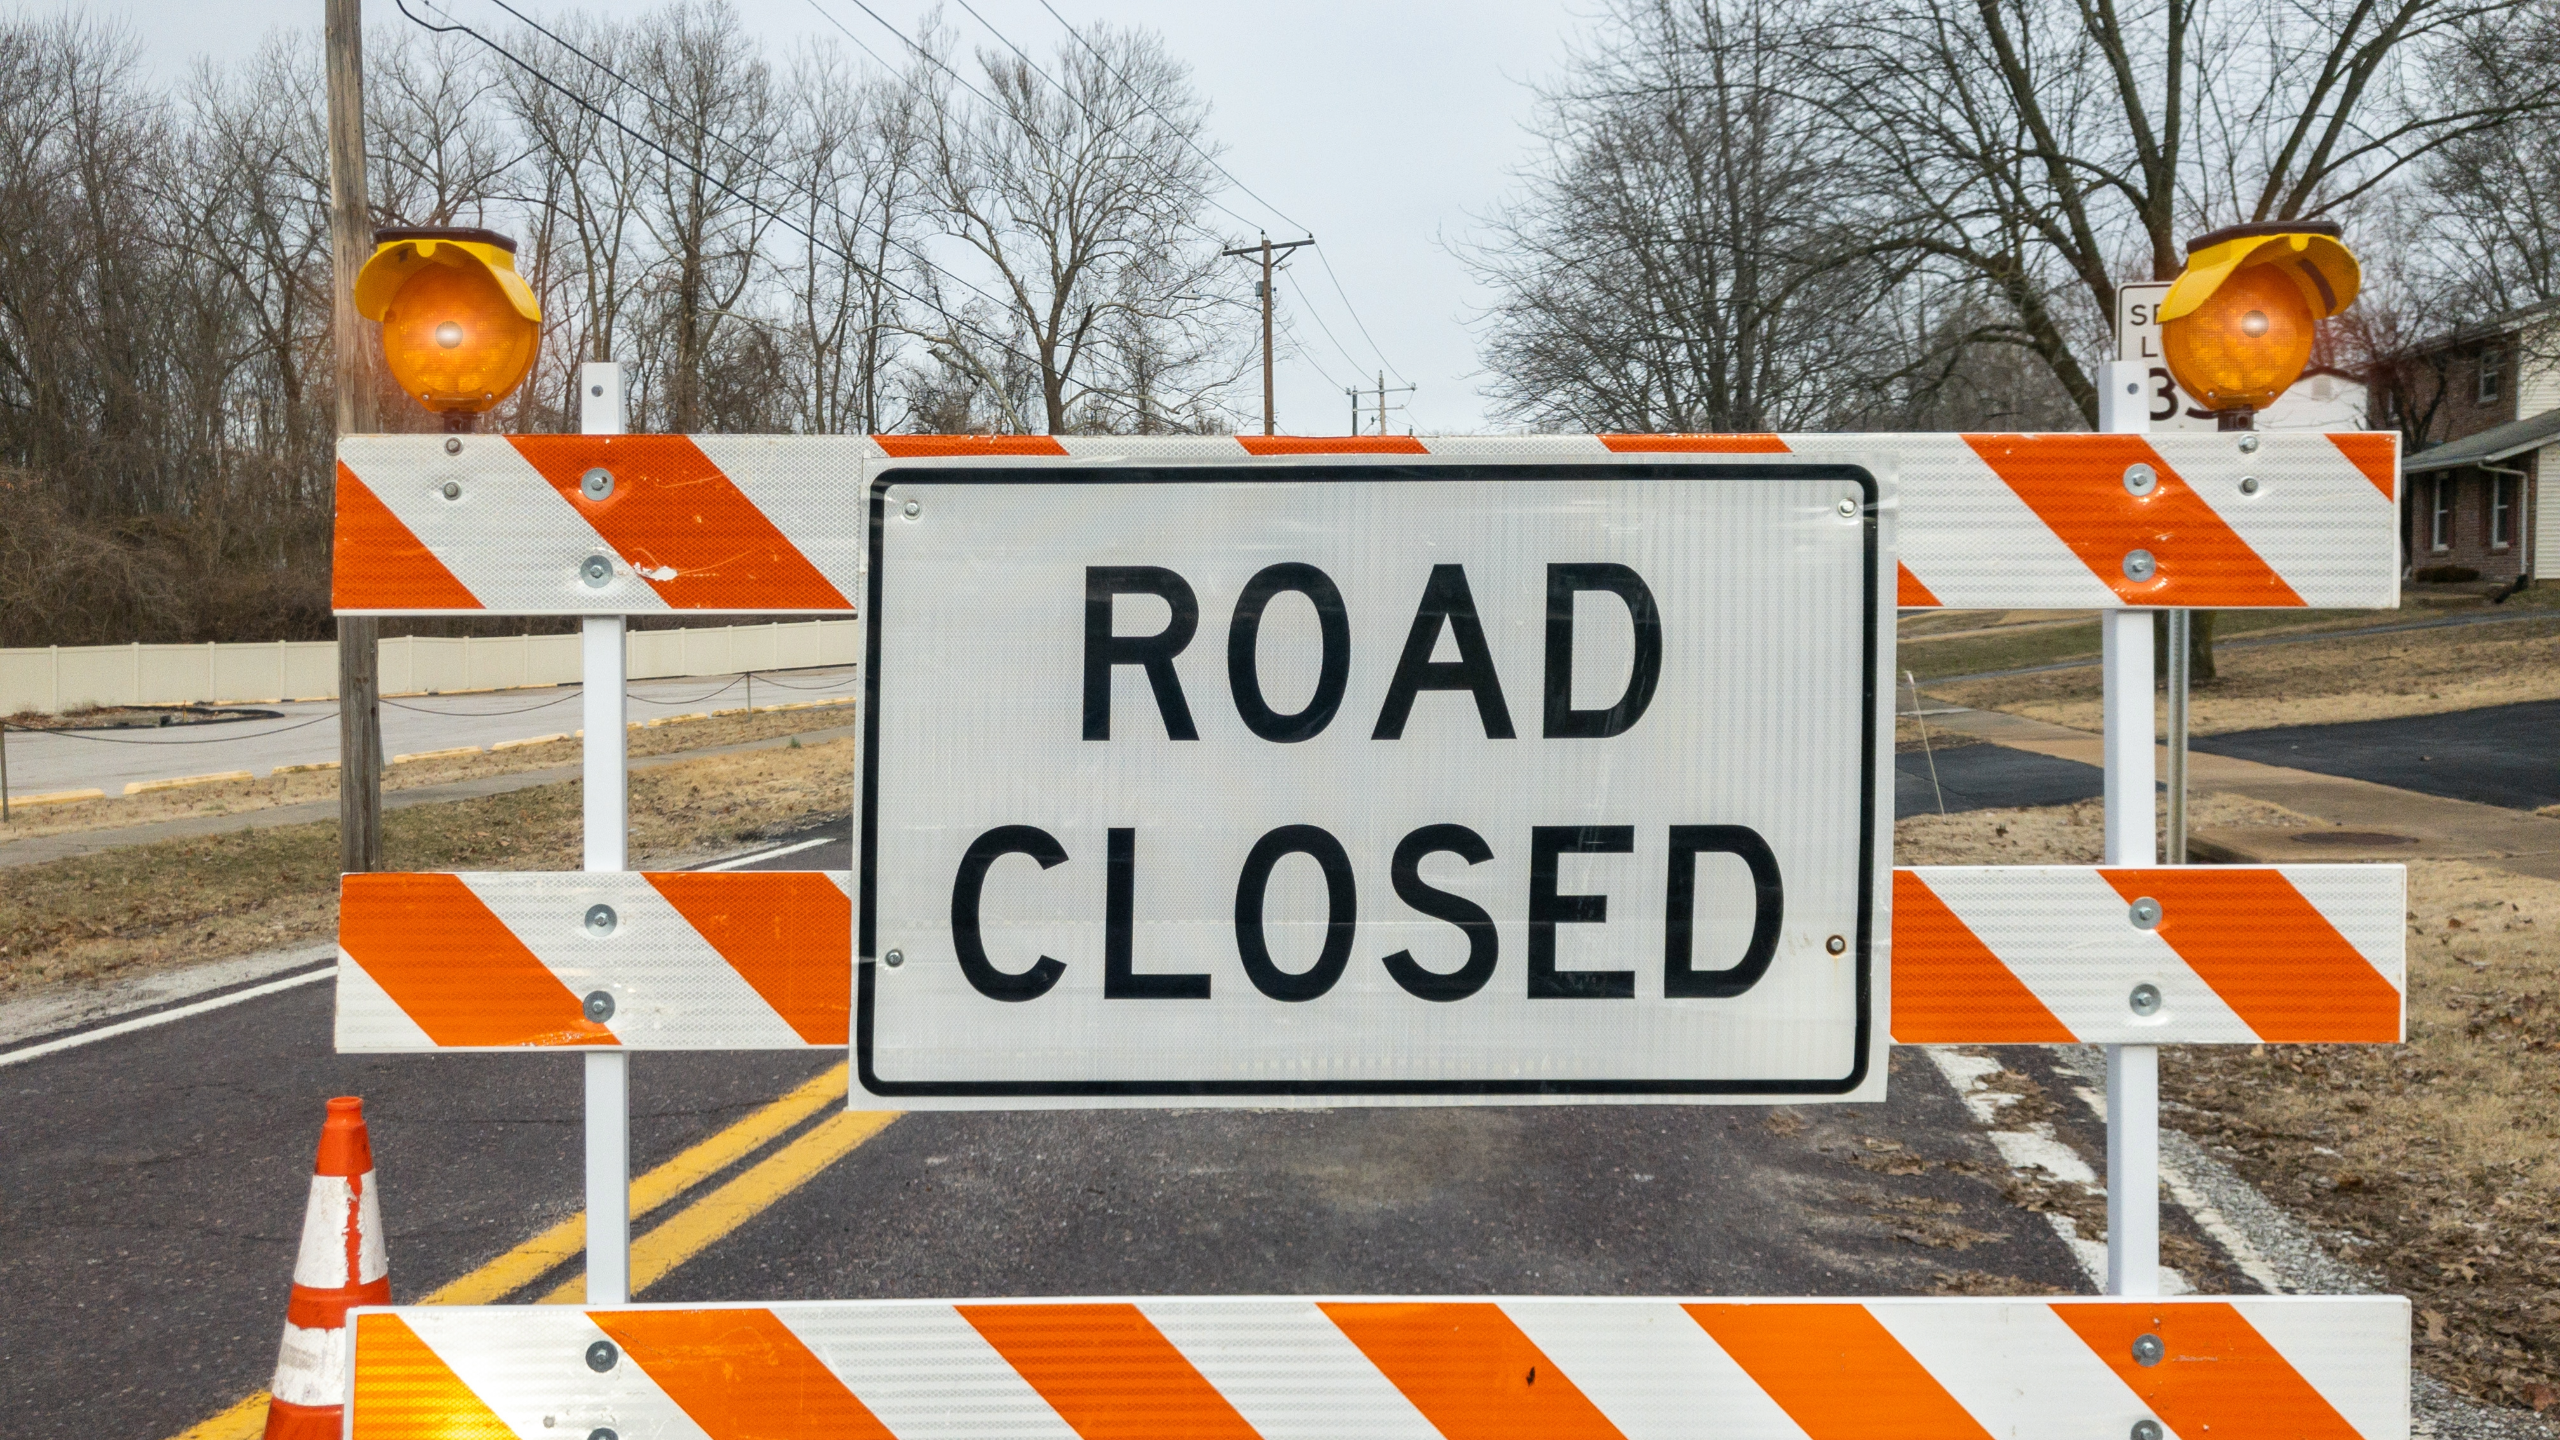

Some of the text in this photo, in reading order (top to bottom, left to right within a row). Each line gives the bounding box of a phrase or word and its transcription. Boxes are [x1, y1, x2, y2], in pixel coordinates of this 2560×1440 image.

[2148, 366, 2219, 421] 3
[1082, 561, 1663, 743] ROAD
[950, 823, 1784, 1002] CLOSED
